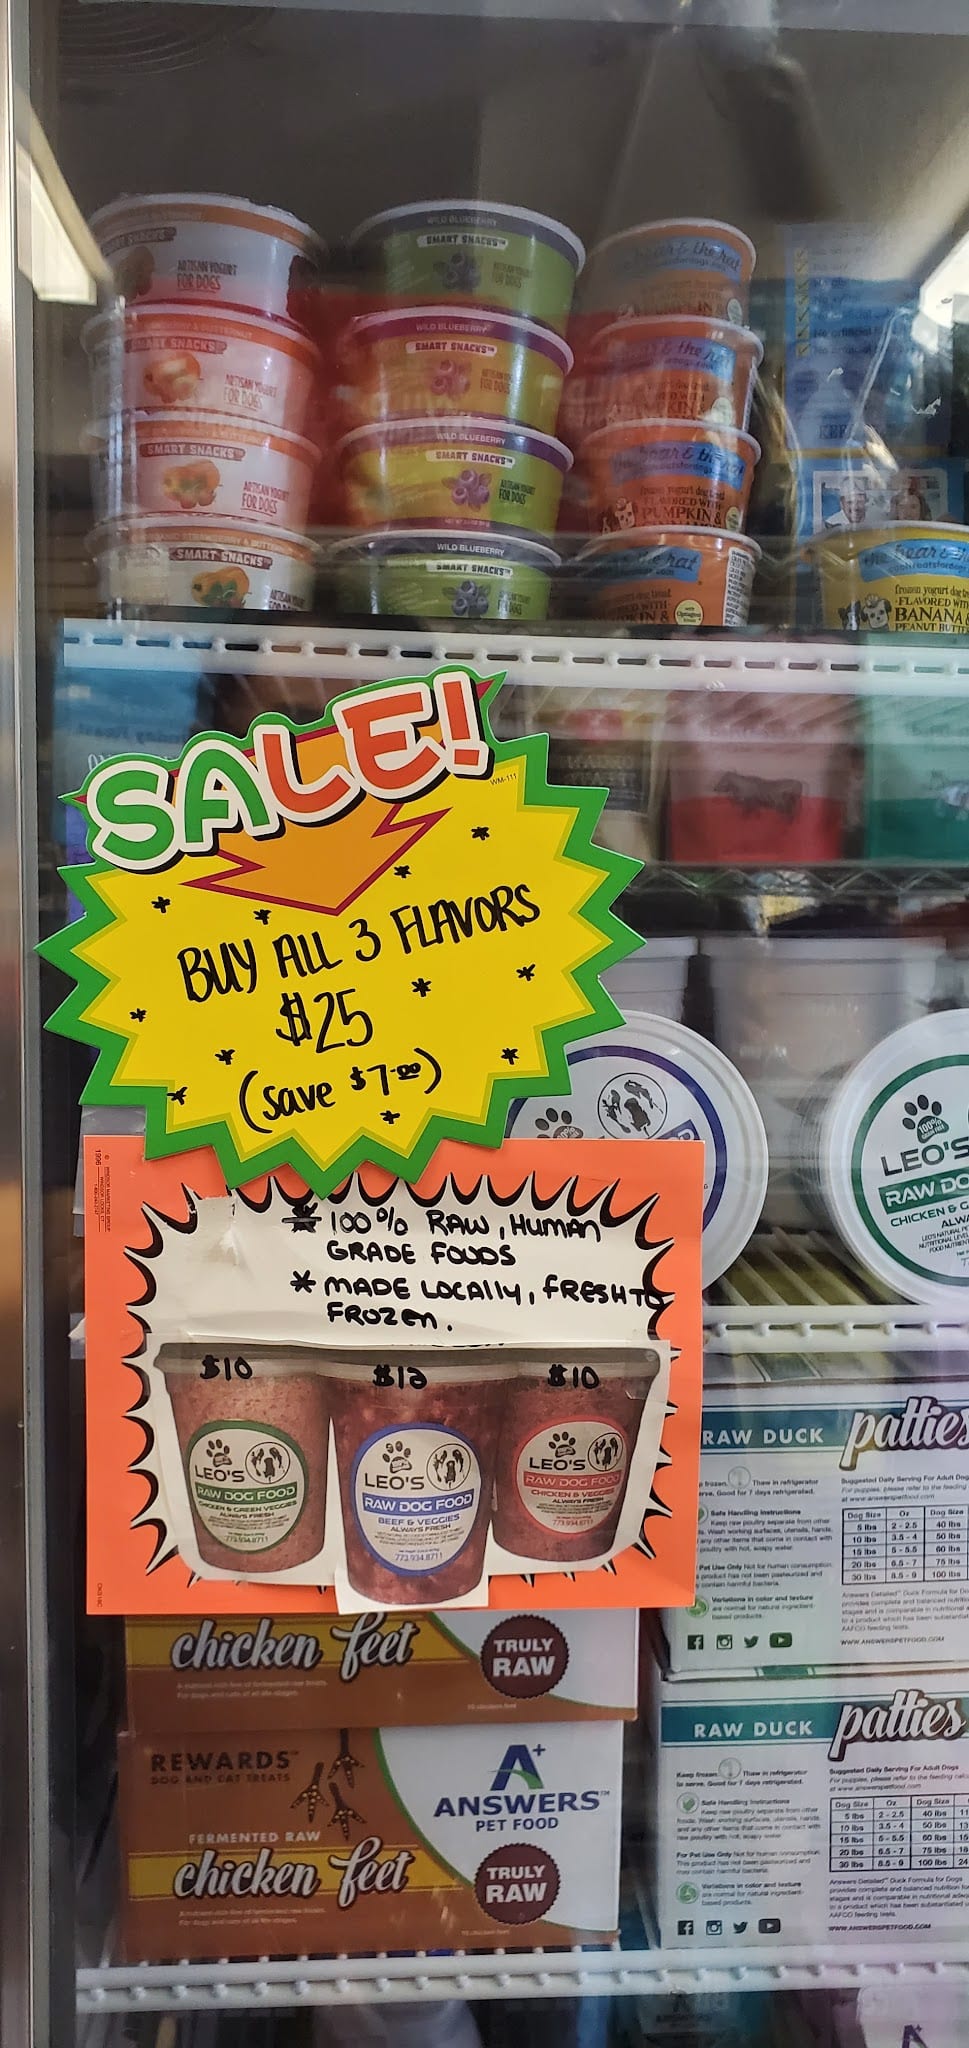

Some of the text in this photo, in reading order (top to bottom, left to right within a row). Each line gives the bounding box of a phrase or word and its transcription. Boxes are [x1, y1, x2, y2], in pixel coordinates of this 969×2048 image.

[427, 235, 458, 245] SMART
[176, 274, 222, 291] FOR DOGS
[416, 322, 488, 334] WILD BLUEBERRY
[415, 341, 448, 351] SMART
[436, 432, 506, 445] WILD BLUEBERRY
[146, 443, 185, 455] SMART
[435, 450, 468, 461] SMART
[243, 480, 290, 501] ARTISAN YOGURT
[498, 488, 527, 505] FOR DOGS
[242, 493, 279, 515] FOR DOGS
[176, 548, 217, 562] SMART
[436, 542, 506, 557] WILD BLUEBERRY
[436, 563, 468, 572] SMART
[895, 583, 962, 599] frozen yogurt dog
[898, 596, 952, 607] FLAVORED
[894, 606, 964, 626] BANANA
[895, 622, 938, 633] PEANUT
[90, 674, 486, 866] SALE!
[177, 883, 541, 1003] BUY ALL 3 FLAVORS
[275, 988, 374, 1054] $25
[238, 1070, 336, 1134] (save
[918, 1117, 943, 1135] 100%
[880, 1136, 969, 1177] LEO'S
[885, 1180, 936, 1208] RAW
[329, 1206, 409, 1236] 100%
[890, 1204, 958, 1228] CHICKEN &
[326, 1240, 517, 1266] GRADE FOODS
[323, 1276, 411, 1300] MADE
[199, 1354, 254, 1382] $10
[547, 1363, 601, 1390] $10
[702, 1427, 825, 1445] RAW DUCK
[839, 1395, 969, 1471] patties
[528, 1456, 587, 1472] LEO'S
[194, 1464, 246, 1483] LEO'S
[364, 1472, 426, 1491] LEO'S
[525, 1474, 620, 1487] RAW DOG FOOD
[197, 1485, 297, 1502] RAW DOG FOOD
[530, 1488, 572, 1499] CHICKEN
[581, 1487, 616, 1498] VEGGIES
[551, 1496, 605, 1505] ALWAYS FRESH
[198, 1500, 226, 1512] CHICKEN
[233, 1504, 263, 1514] GREEN
[263, 1499, 298, 1512] VEGGIES
[364, 1492, 473, 1513] RAW DOG FOOD
[219, 1510, 276, 1520] ALWAYS FRESH
[378, 1513, 461, 1526] BEEF & VEGGIES
[727, 1509, 760, 1518] Handling
[390, 1523, 452, 1533] ALWAYS FRESH
[171, 1611, 420, 1682] chicken feet
[493, 1638, 554, 1653] TRULY
[492, 1655, 556, 1678] RAW
[693, 1720, 813, 1738] RAW DUCK
[827, 1689, 967, 1762] patties
[151, 1772, 291, 1786] DOG AND CAT TREATS
[475, 1816, 560, 1833] PET FOOD
[188, 1830, 322, 1845] FERMENTED RAW
[918, 1859, 933, 1867] 100
[173, 1835, 415, 1909] chicken feet
[486, 1864, 546, 1880] TRULY
[485, 1882, 548, 1905] RAW
